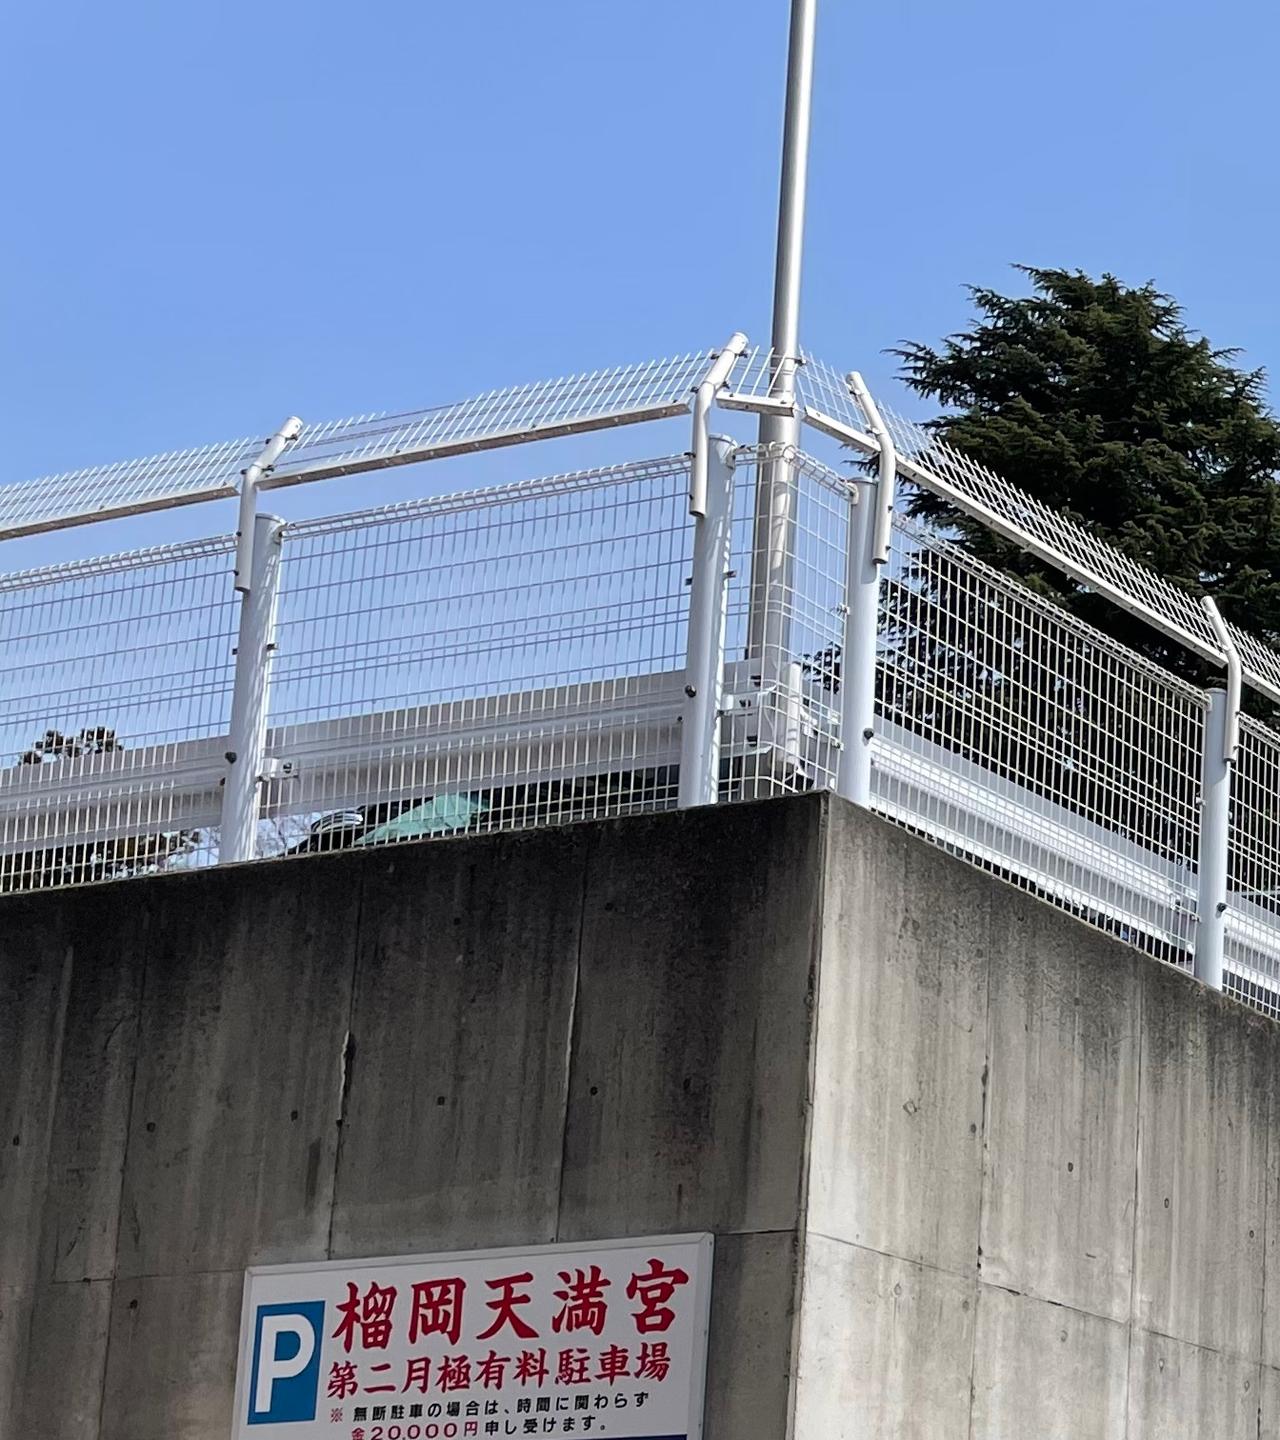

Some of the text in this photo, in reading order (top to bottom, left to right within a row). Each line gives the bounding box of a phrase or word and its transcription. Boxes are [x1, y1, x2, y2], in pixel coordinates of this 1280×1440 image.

[331, 1259, 689, 1353] 榴岡天満宮
[254, 1313, 315, 1413] P
[326, 1341, 671, 1400] 第二月極有料駐車場
